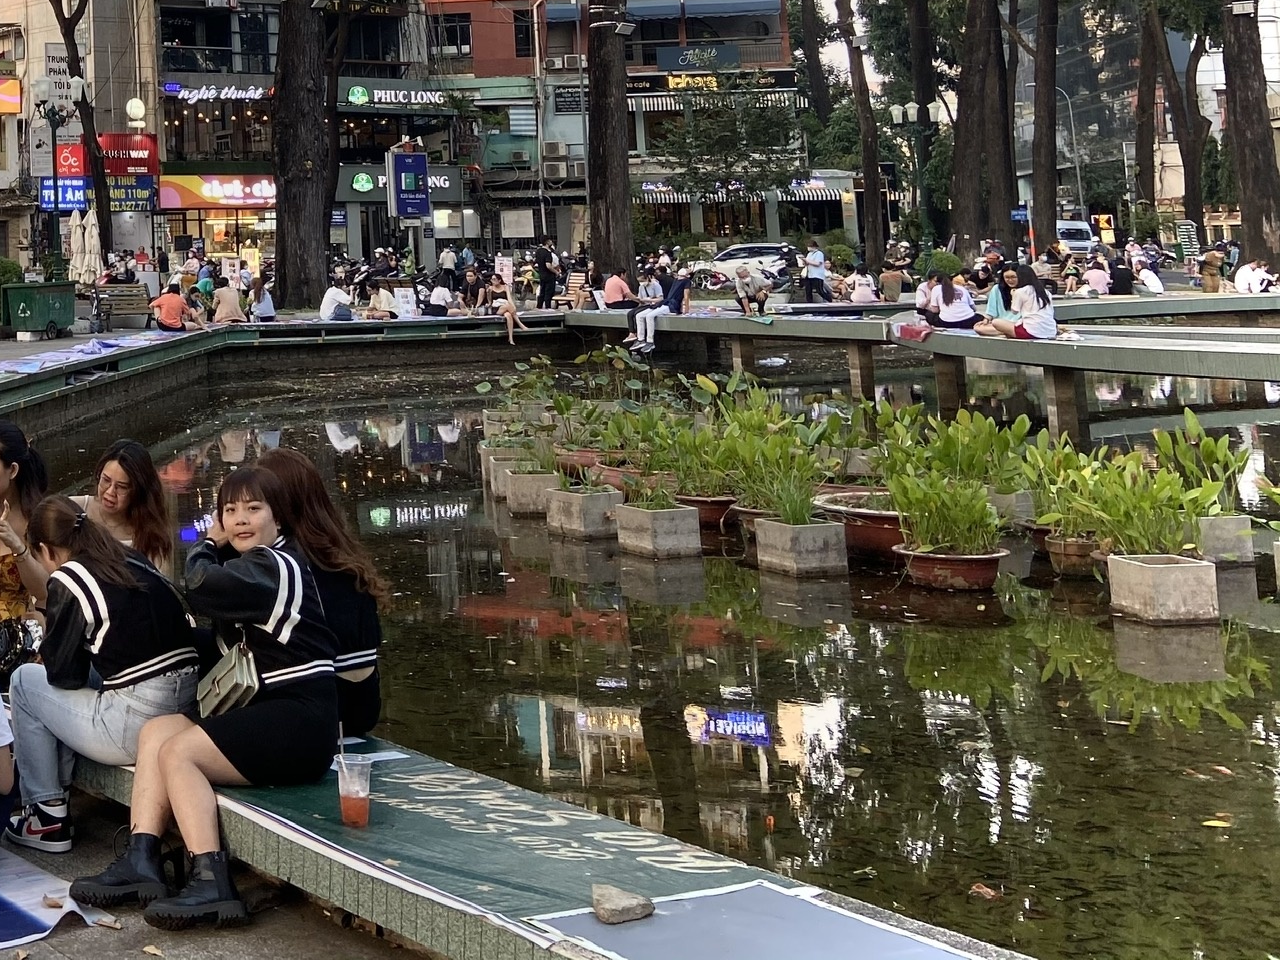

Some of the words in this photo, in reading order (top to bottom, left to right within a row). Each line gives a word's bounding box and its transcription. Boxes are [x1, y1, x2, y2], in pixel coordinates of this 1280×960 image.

[47, 55, 69, 64] TRUNG
[164, 84, 180, 92] CAFE
[178, 84, 218, 104] nghệ
[220, 84, 264, 103] thuật
[410, 90, 445, 104] LONG
